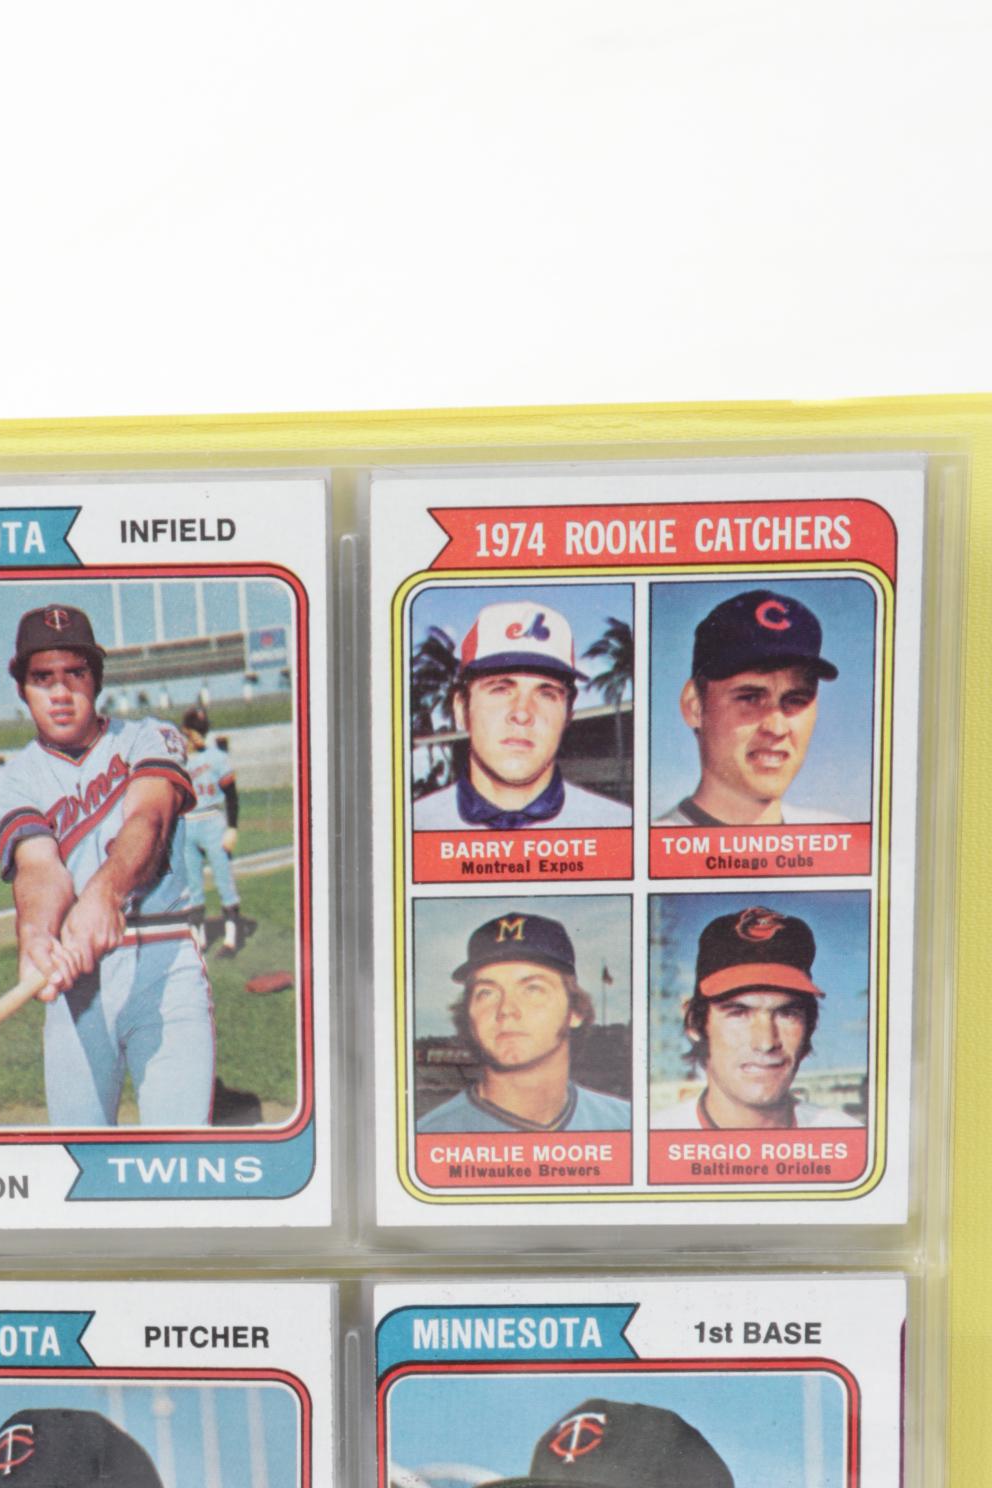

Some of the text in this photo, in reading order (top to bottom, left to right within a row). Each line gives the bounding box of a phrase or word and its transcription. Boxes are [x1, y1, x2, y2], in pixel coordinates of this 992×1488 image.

[120, 518, 237, 544] INFIELD
[475, 514, 852, 558] 1974 ROOKIE CATCHERS
[440, 838, 597, 860] BARRY FOOTE
[662, 833, 852, 855] TOM LUNDSTEDT
[461, 859, 584, 875] Montreal Expos
[704, 854, 814, 871] Chicago Cubs
[495, 917, 526, 942] M
[429, 1144, 613, 1164] CHARLIE MOORE
[668, 1142, 848, 1161] SERGIO ROBLES
[107, 1156, 263, 1184] TWINS
[448, 1163, 601, 1178] Milwaukee Brewers
[690, 1161, 832, 1176] Baltimore Orioles
[144, 1325, 269, 1349] PITCHER
[412, 1316, 603, 1350] MINNESOTA
[694, 1321, 822, 1345] 1st BASE
